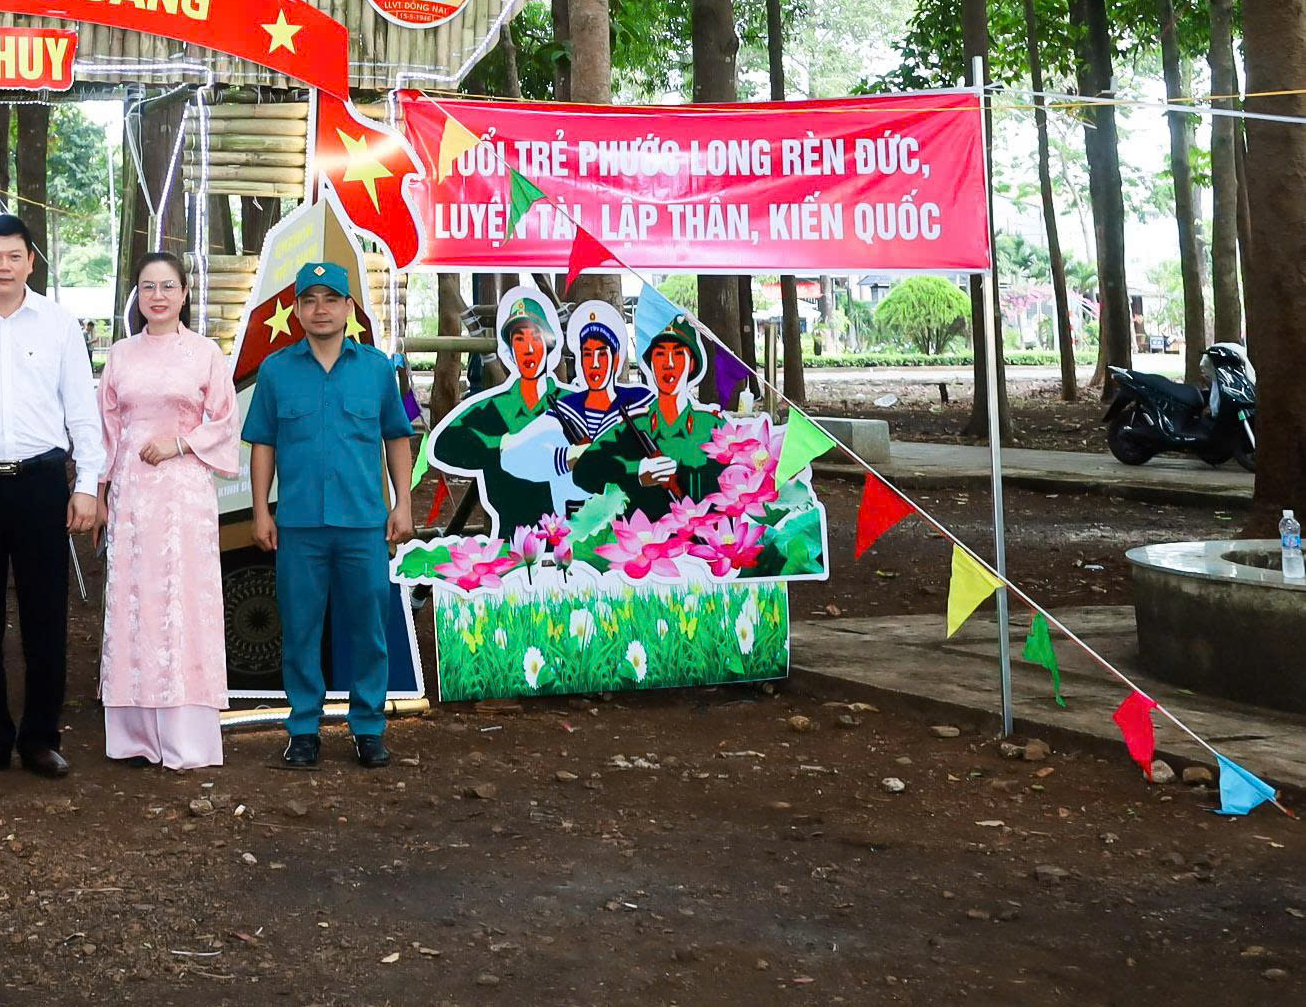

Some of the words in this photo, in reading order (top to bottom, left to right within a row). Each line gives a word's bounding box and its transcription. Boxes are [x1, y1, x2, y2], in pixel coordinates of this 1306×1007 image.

[514, 129, 569, 177] TRẺ
[578, 131, 682, 177] PHƯỚC
[690, 138, 772, 176] LONG
[783, 130, 845, 176] RÈN
[854, 129, 932, 181] ĐỨC,
[601, 196, 658, 247] LẬP
[668, 197, 759, 246] THÂN,
[769, 191, 845, 241] KIẾN
[854, 190, 941, 245] QUỐC
